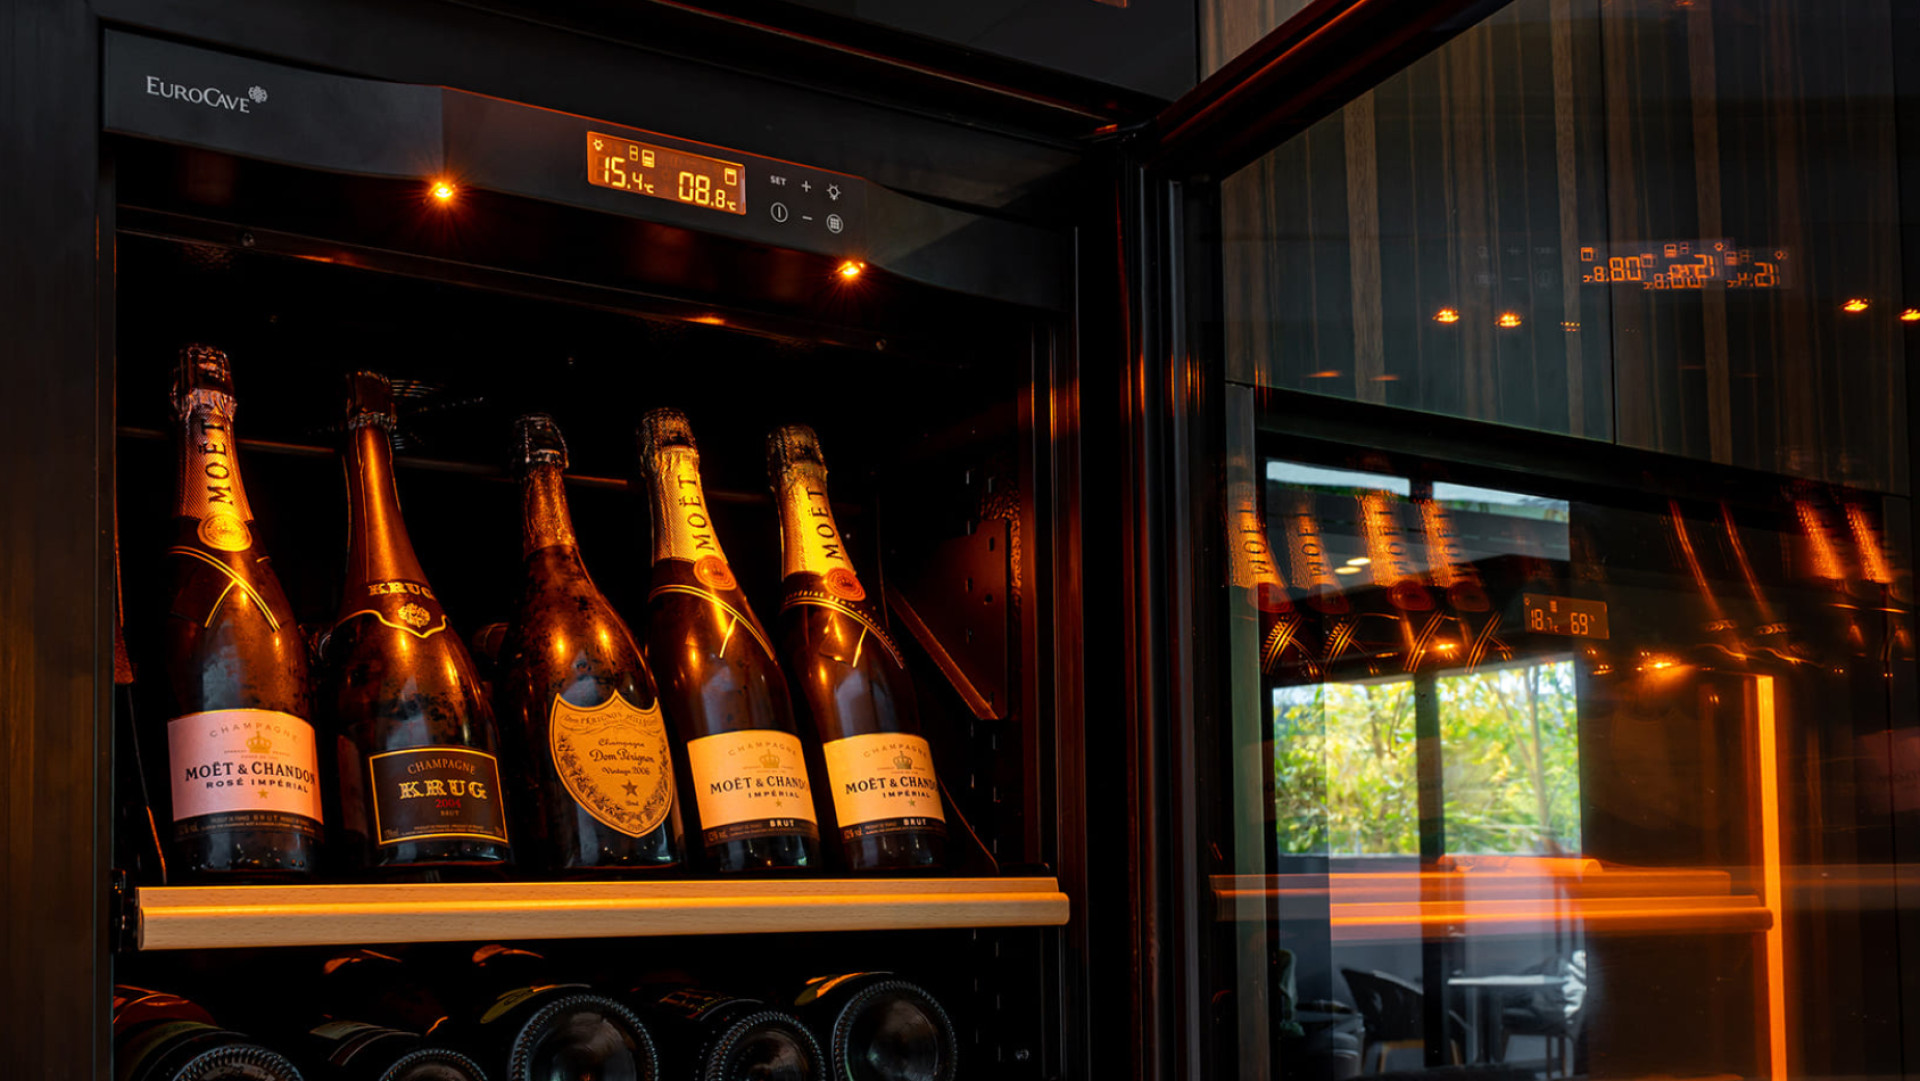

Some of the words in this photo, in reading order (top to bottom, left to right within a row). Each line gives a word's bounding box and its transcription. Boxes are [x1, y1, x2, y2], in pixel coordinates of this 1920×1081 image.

[769, 175, 787, 186] SET
[677, 474, 715, 551] MOËT
[805, 486, 844, 561] MOËT
[209, 721, 299, 743] CHAMPAGNE
[727, 741, 797, 756] CHAMPAGNE
[237, 763, 249, 775] &
[407, 758, 476, 776] CHAMPAGNE
[206, 777, 244, 789] ROSÉ
[251, 778, 309, 793] IMPÉRIAL
[755, 778, 764, 788] &
[889, 778, 898, 788] &
[398, 779, 488, 800] KRUG
[748, 790, 800, 799] IMPÉRIAL
[882, 790, 931, 799] IMPÉRIAL
[769, 819, 795, 827] BRUT
[903, 818, 927, 826] BRUT
